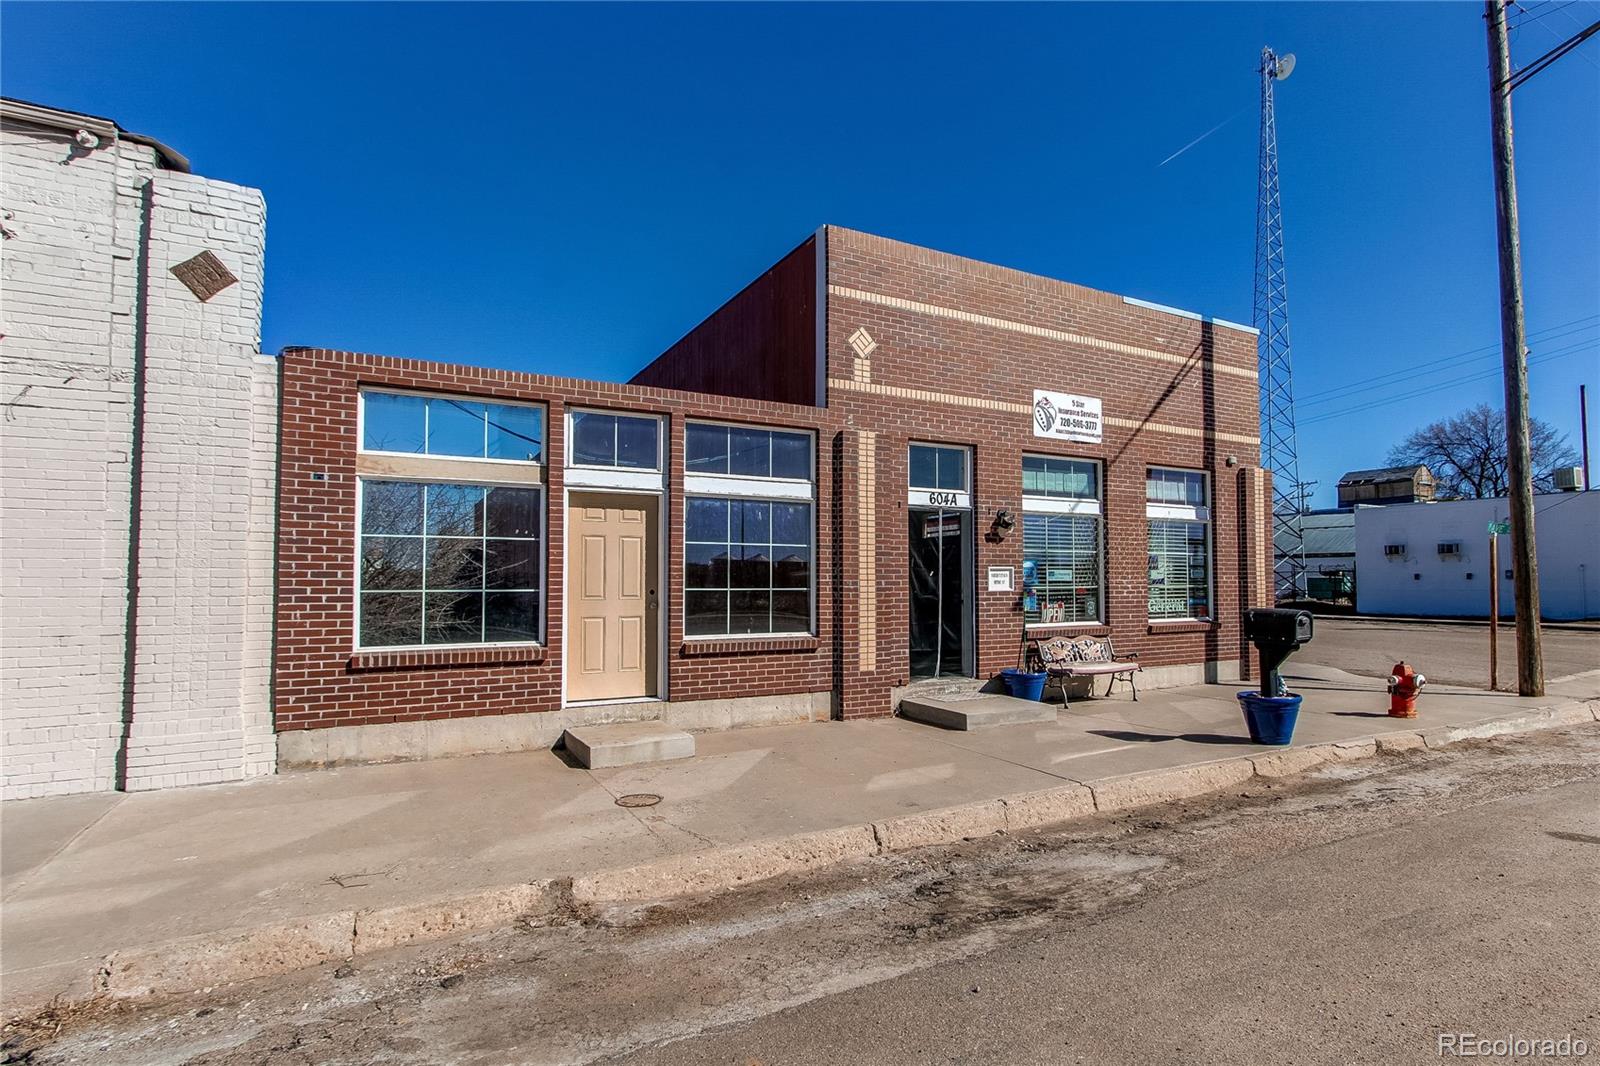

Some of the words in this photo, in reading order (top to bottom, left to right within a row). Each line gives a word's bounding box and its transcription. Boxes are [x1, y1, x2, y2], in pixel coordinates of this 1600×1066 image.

[1058, 408, 1079, 416] Insurance
[1080, 411, 1099, 419] Services
[929, 492, 957, 505] 604A
[1041, 608, 1065, 622] OPEN
